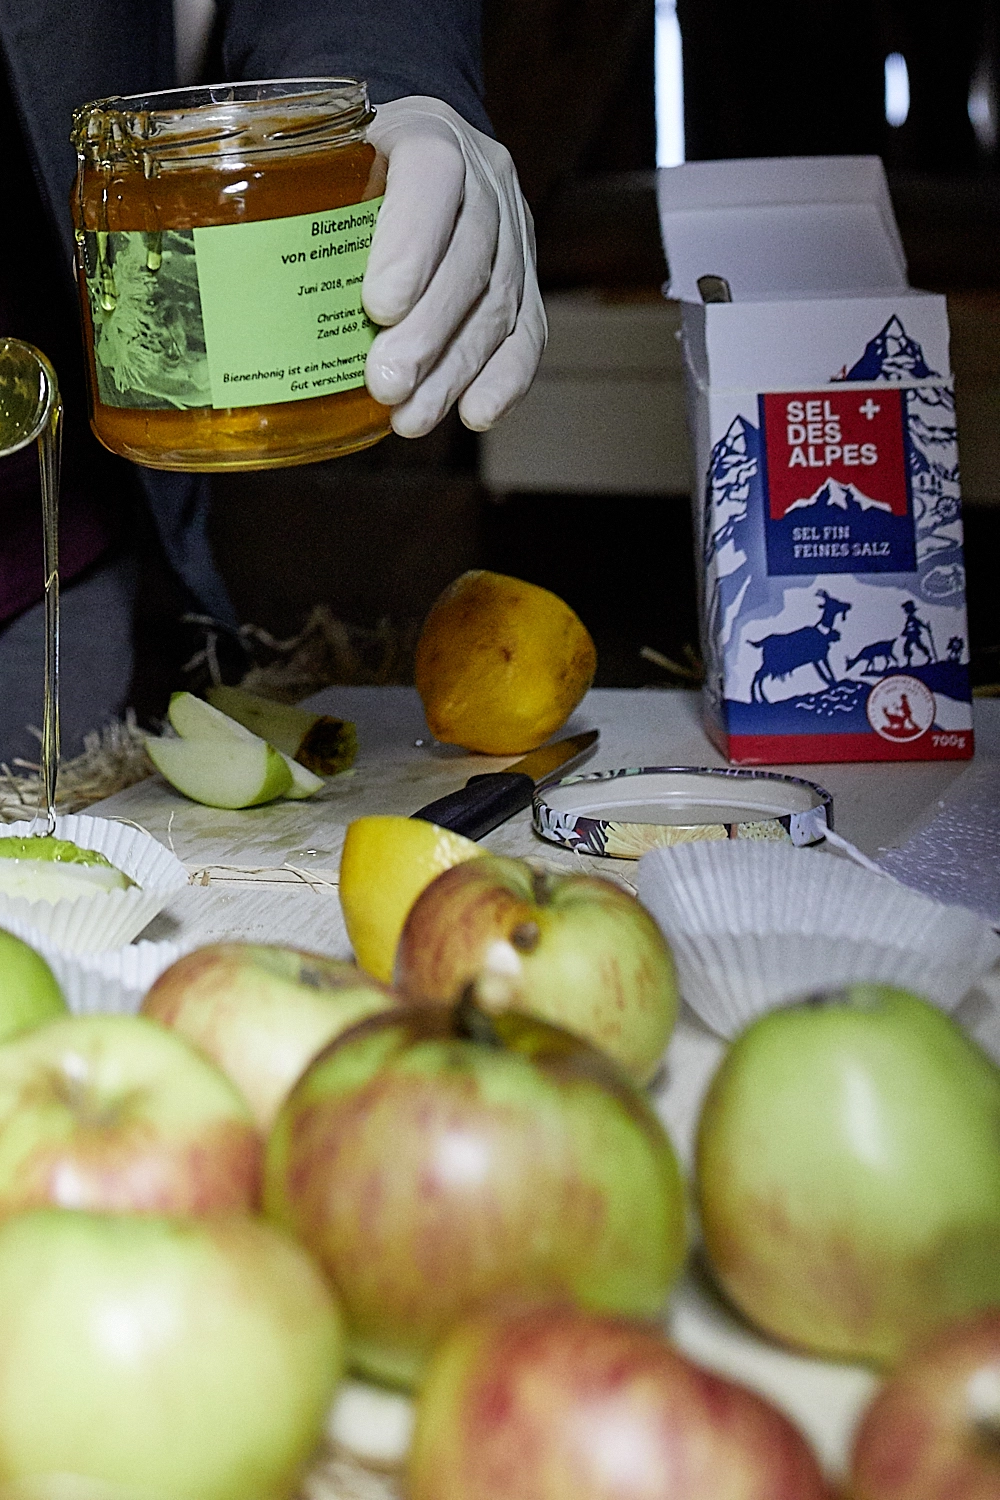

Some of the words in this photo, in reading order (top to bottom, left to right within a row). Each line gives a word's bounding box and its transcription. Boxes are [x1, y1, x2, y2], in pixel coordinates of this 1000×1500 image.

[281, 252, 306, 265] von
[298, 282, 318, 296] Juni
[321, 278, 344, 292] 2018,
[317, 326, 339, 339] Zand
[223, 368, 285, 383] Bienenhonig
[288, 365, 301, 375] ist
[304, 362, 319, 373] ein
[290, 380, 308, 392] Gut
[786, 399, 840, 423] SEL
[786, 421, 842, 446] DES
[788, 443, 878, 468] ALPES
[792, 526, 820, 541] SEL
[823, 525, 850, 540] FIN
[793, 543, 850, 558] FEINES
[852, 542, 891, 557] SALZ
[931, 734, 966, 749] 700g
